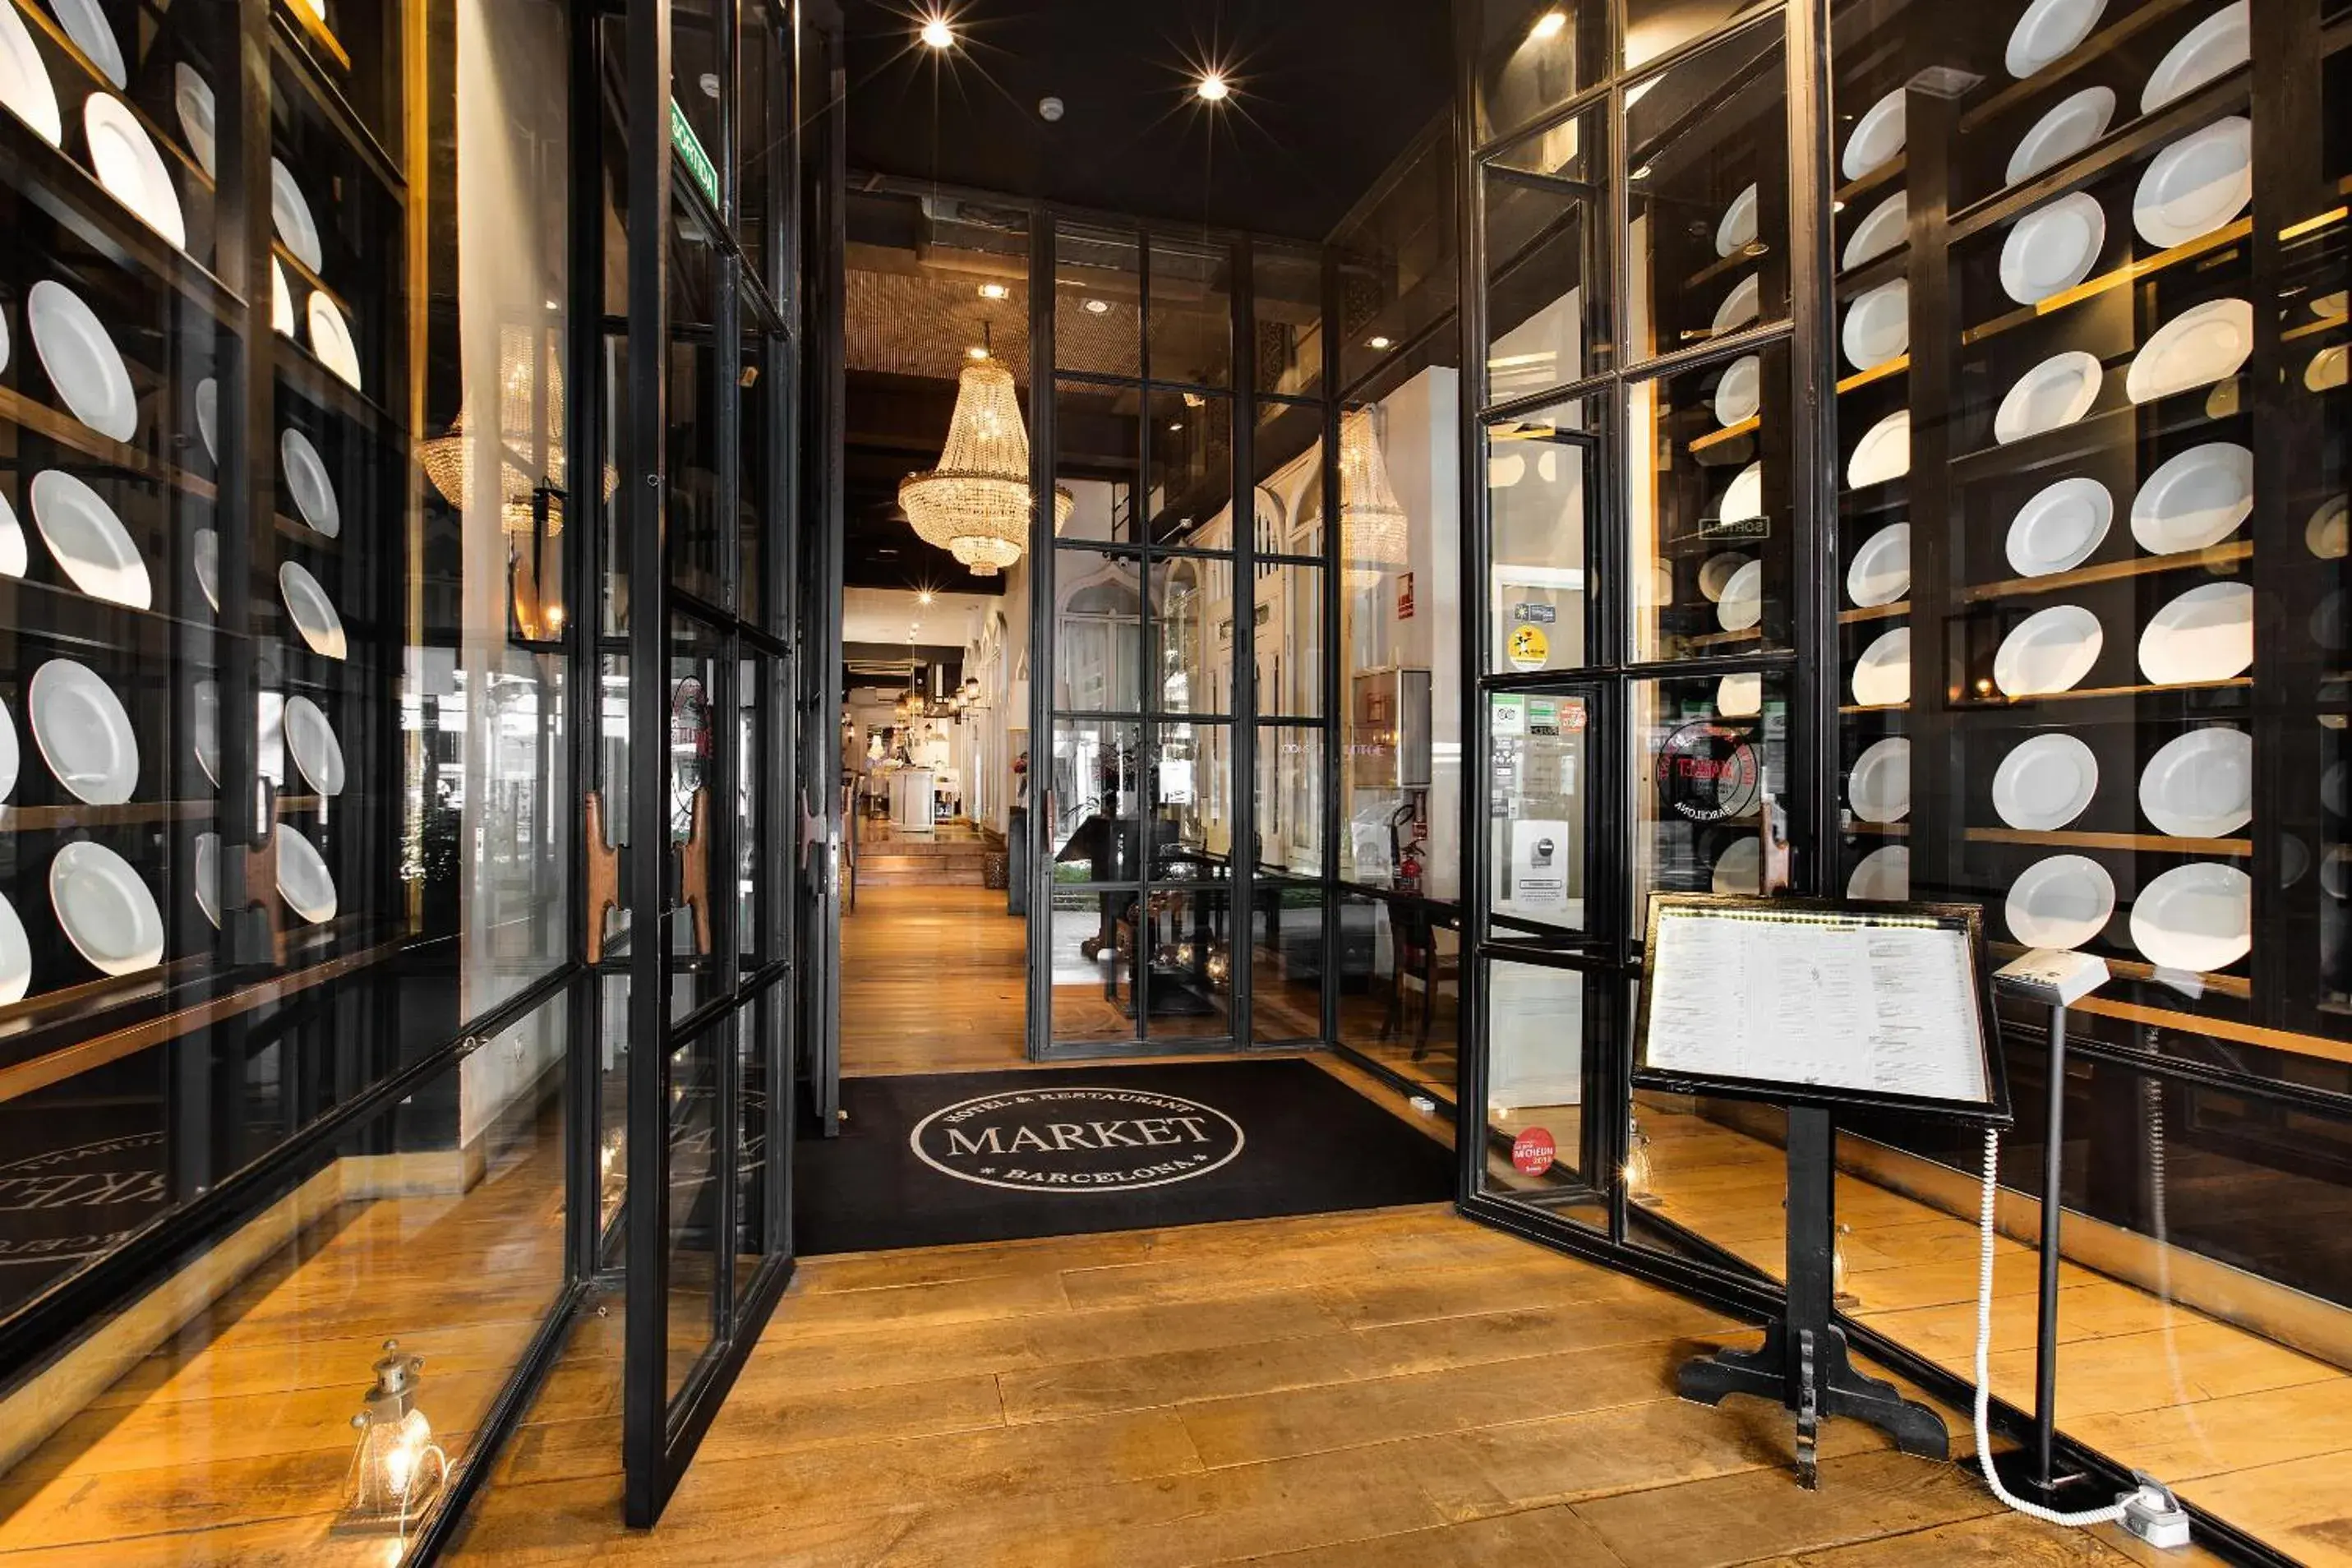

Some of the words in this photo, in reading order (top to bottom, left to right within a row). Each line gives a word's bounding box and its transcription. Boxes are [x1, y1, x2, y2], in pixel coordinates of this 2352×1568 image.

[943, 1100, 1012, 1123] HOTEL
[1039, 1092, 1196, 1112] RESTAURANT
[943, 1117, 1212, 1156] MARKET
[1003, 1160, 1196, 1183] BARCELONA
